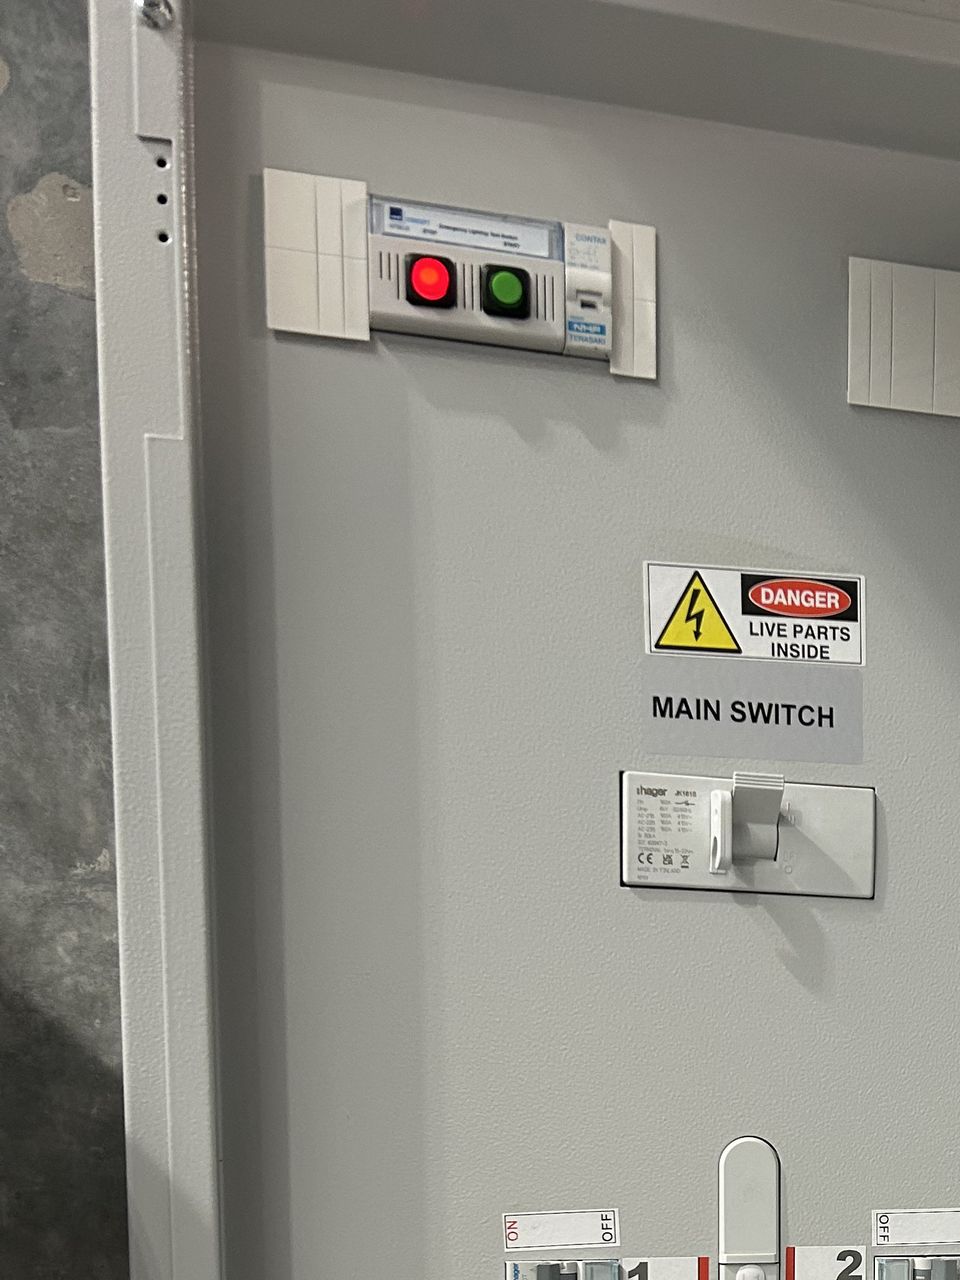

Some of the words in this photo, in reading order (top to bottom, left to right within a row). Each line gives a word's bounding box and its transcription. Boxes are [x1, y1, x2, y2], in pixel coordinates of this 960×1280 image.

[761, 587, 840, 609] DANGER
[750, 622, 787, 638] LIVE
[793, 624, 850, 641] PARTS
[771, 643, 830, 660] INSIDE
[652, 696, 720, 721] MAIN
[731, 700, 834, 728] SWITCH
[507, 1221, 518, 1241] ON
[601, 1213, 613, 1241] OFF
[879, 1215, 889, 1242] OFF
